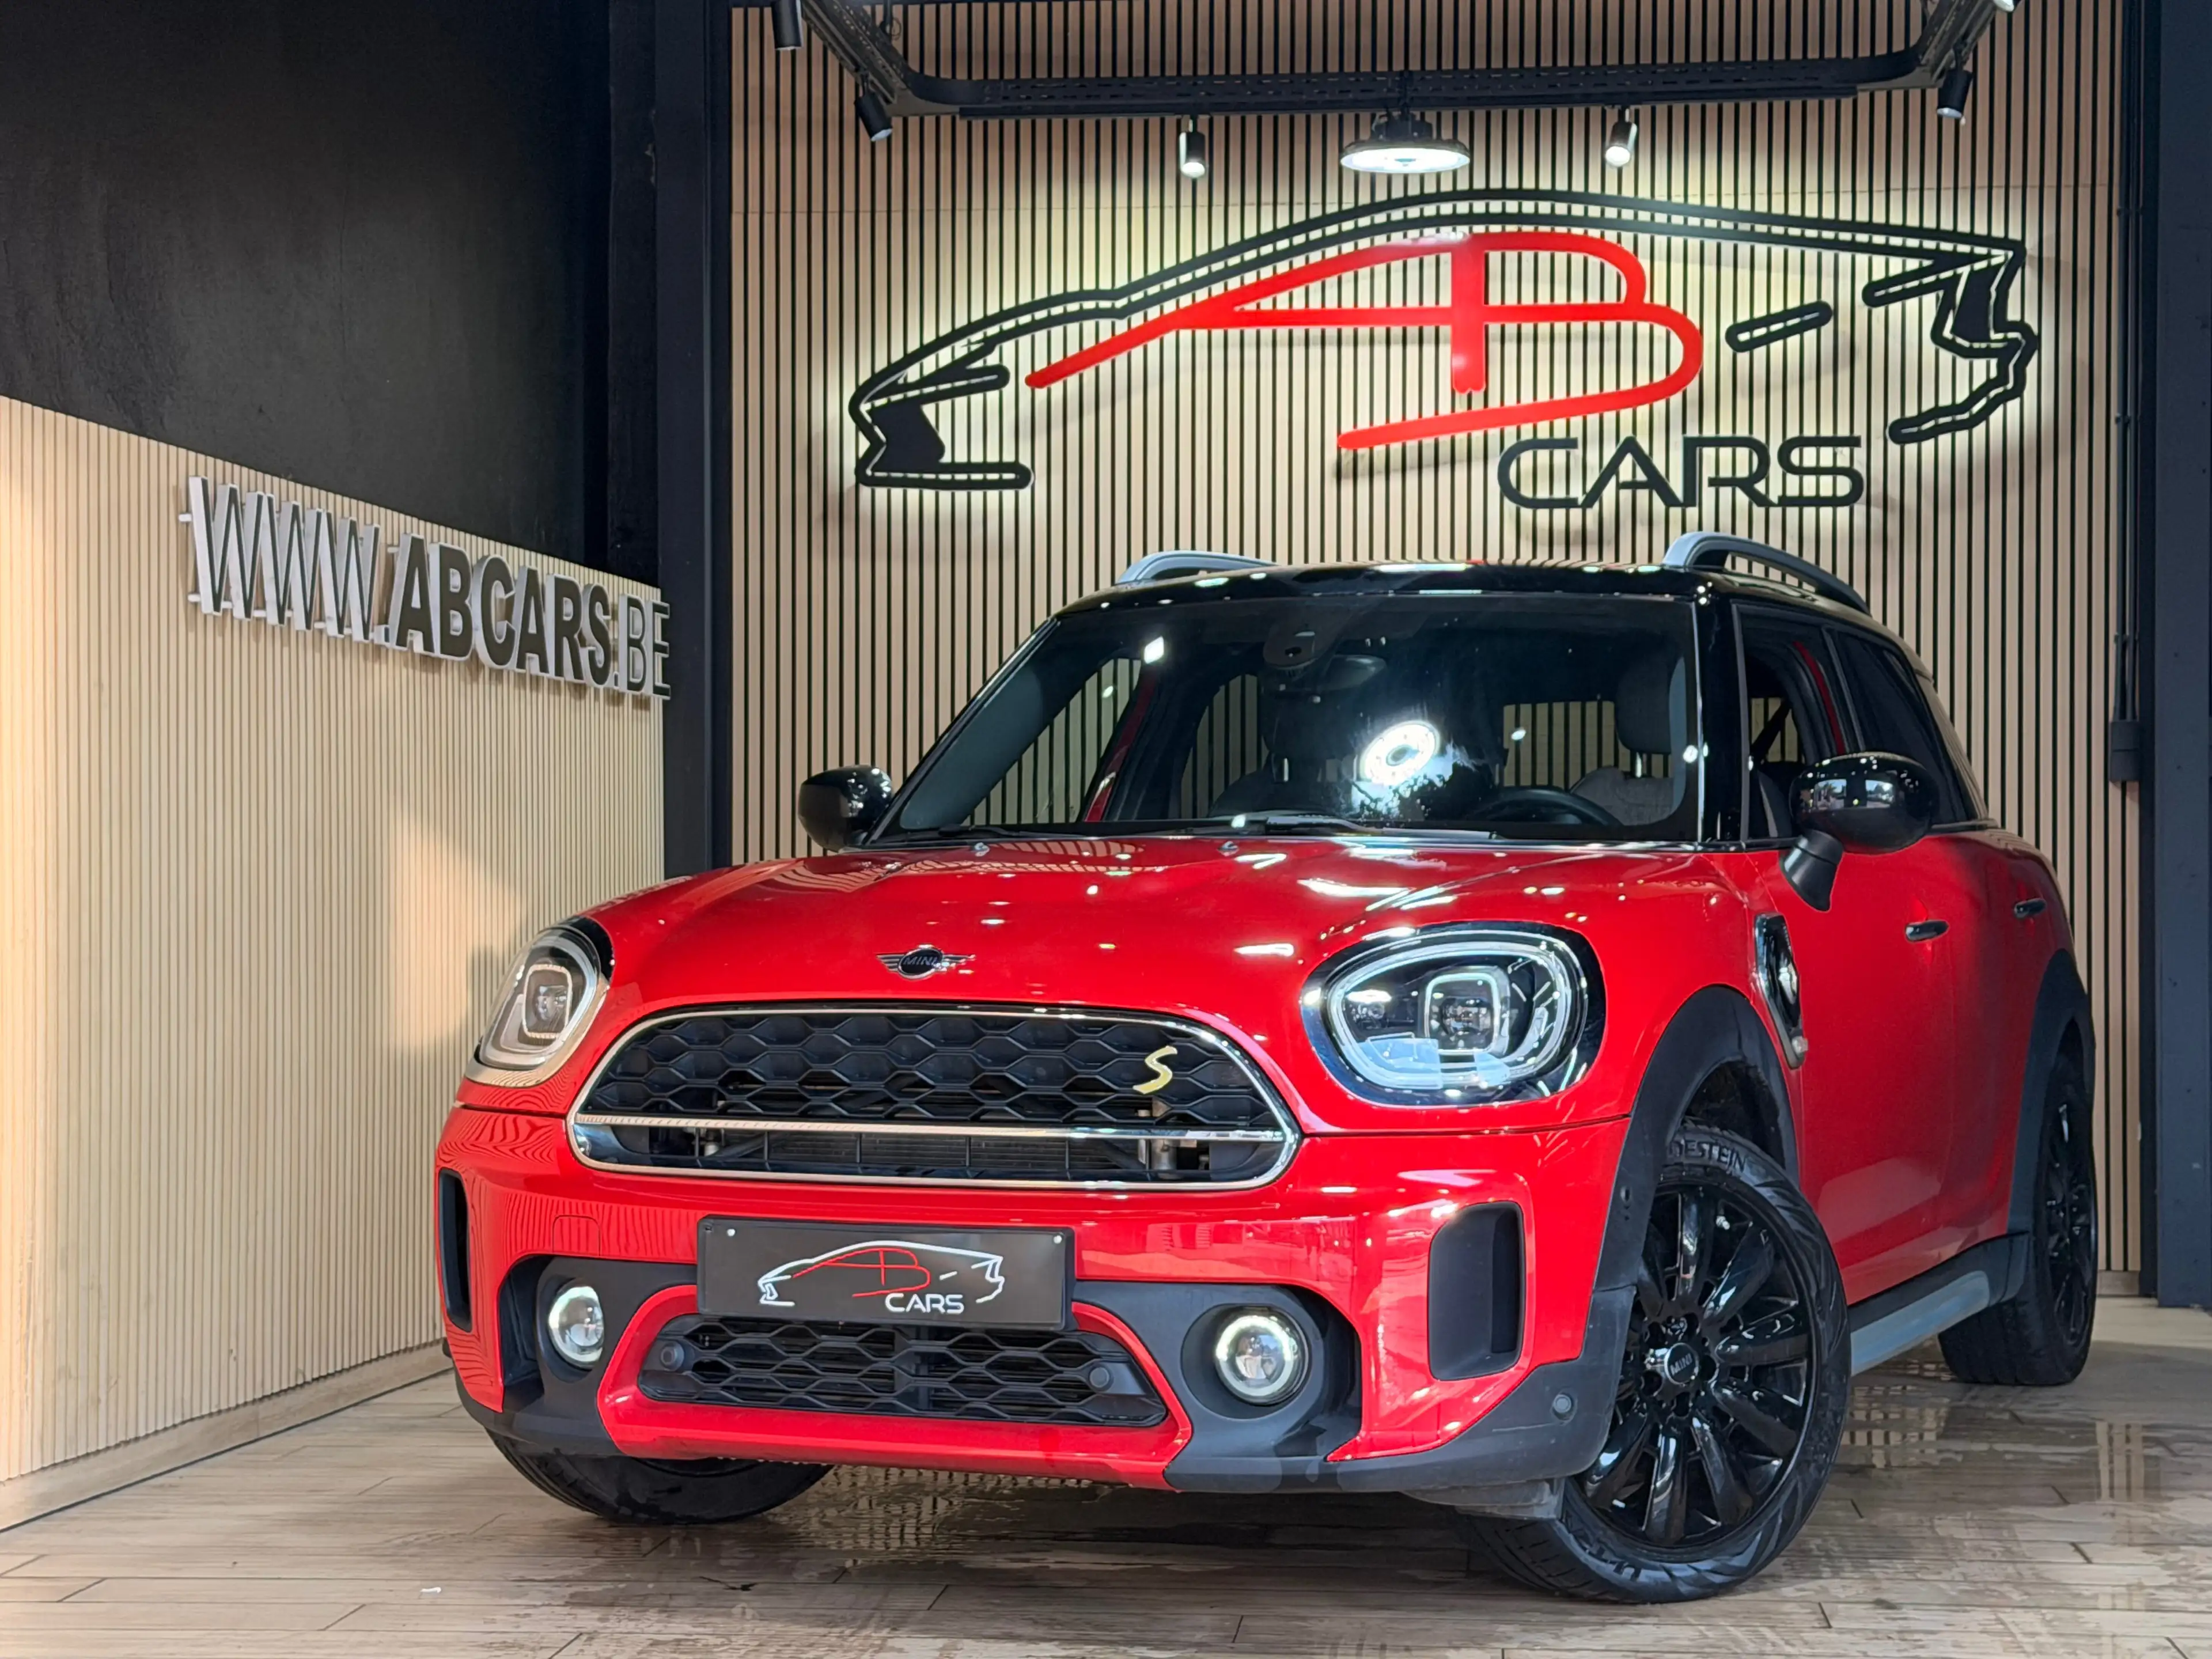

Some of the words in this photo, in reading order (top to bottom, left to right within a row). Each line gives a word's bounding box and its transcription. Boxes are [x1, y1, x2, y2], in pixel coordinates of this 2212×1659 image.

[1497, 435, 1864, 509] CARS
[188, 475, 672, 700] WWW.ABCARS.BE
[1132, 1045, 1178, 1094] S
[885, 1293, 964, 1315] CARS
[1670, 1353, 1693, 1376] MINI
